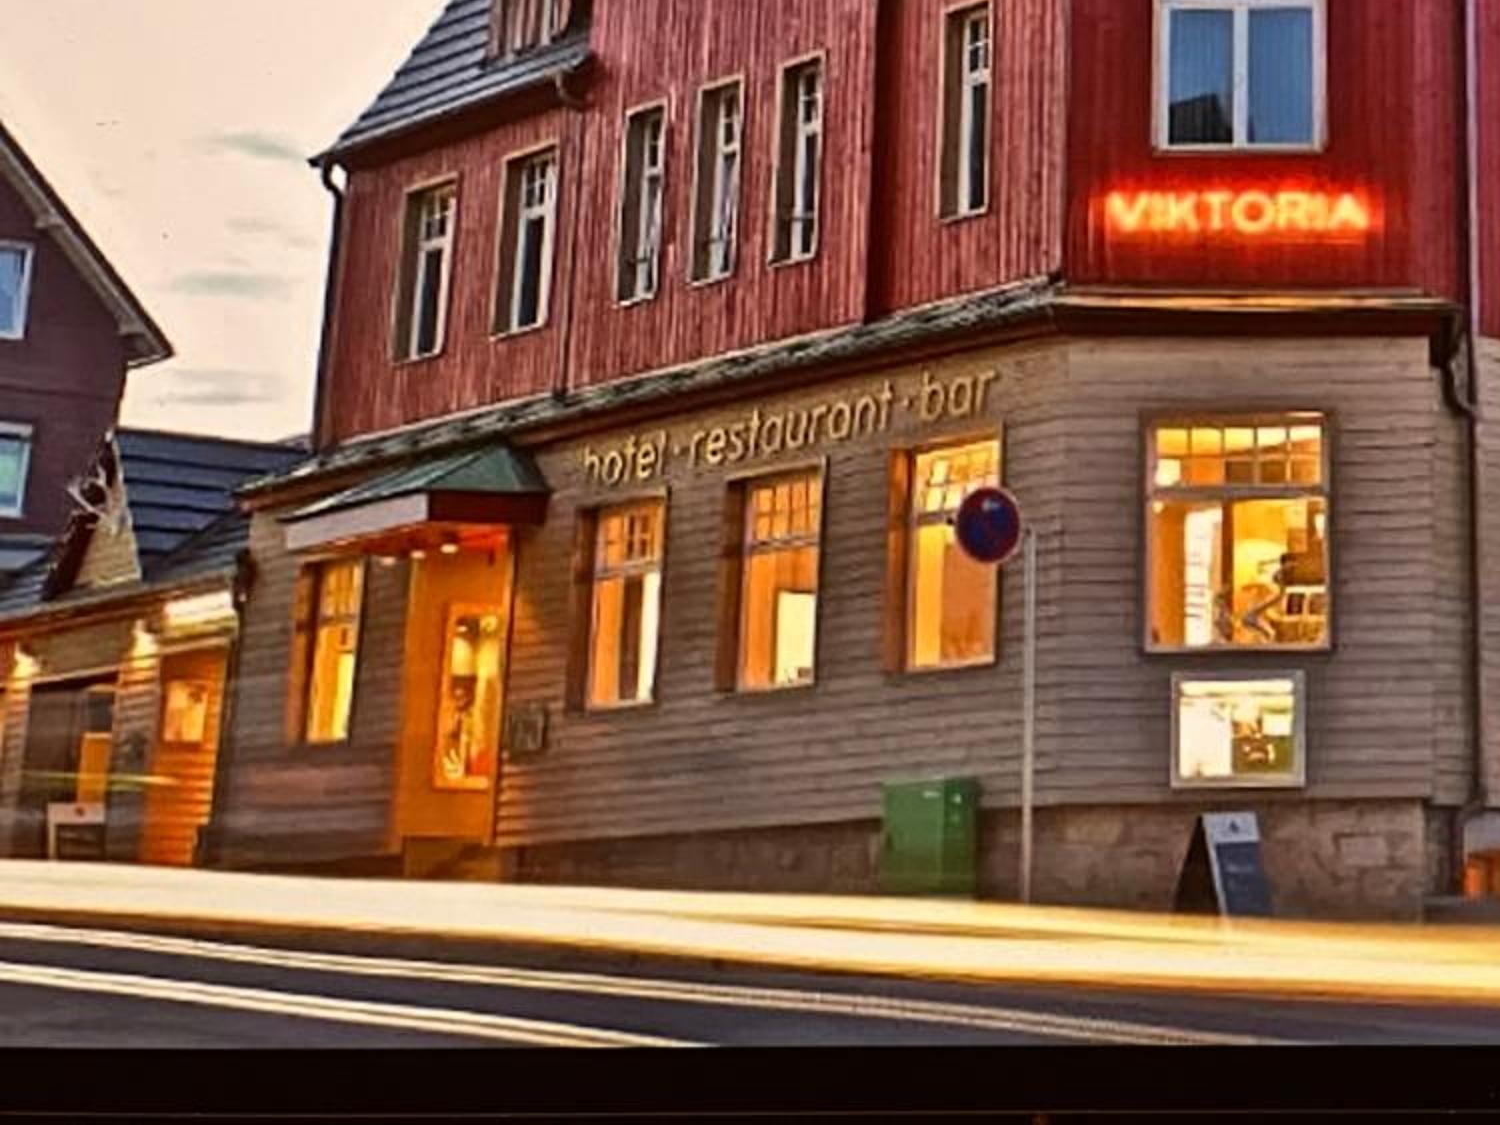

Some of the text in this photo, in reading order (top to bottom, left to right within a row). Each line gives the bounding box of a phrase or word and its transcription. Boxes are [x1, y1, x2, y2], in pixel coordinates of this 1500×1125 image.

[1106, 189, 1369, 233] VIKTORIA
[583, 371, 998, 485] hotel restaurant bar
